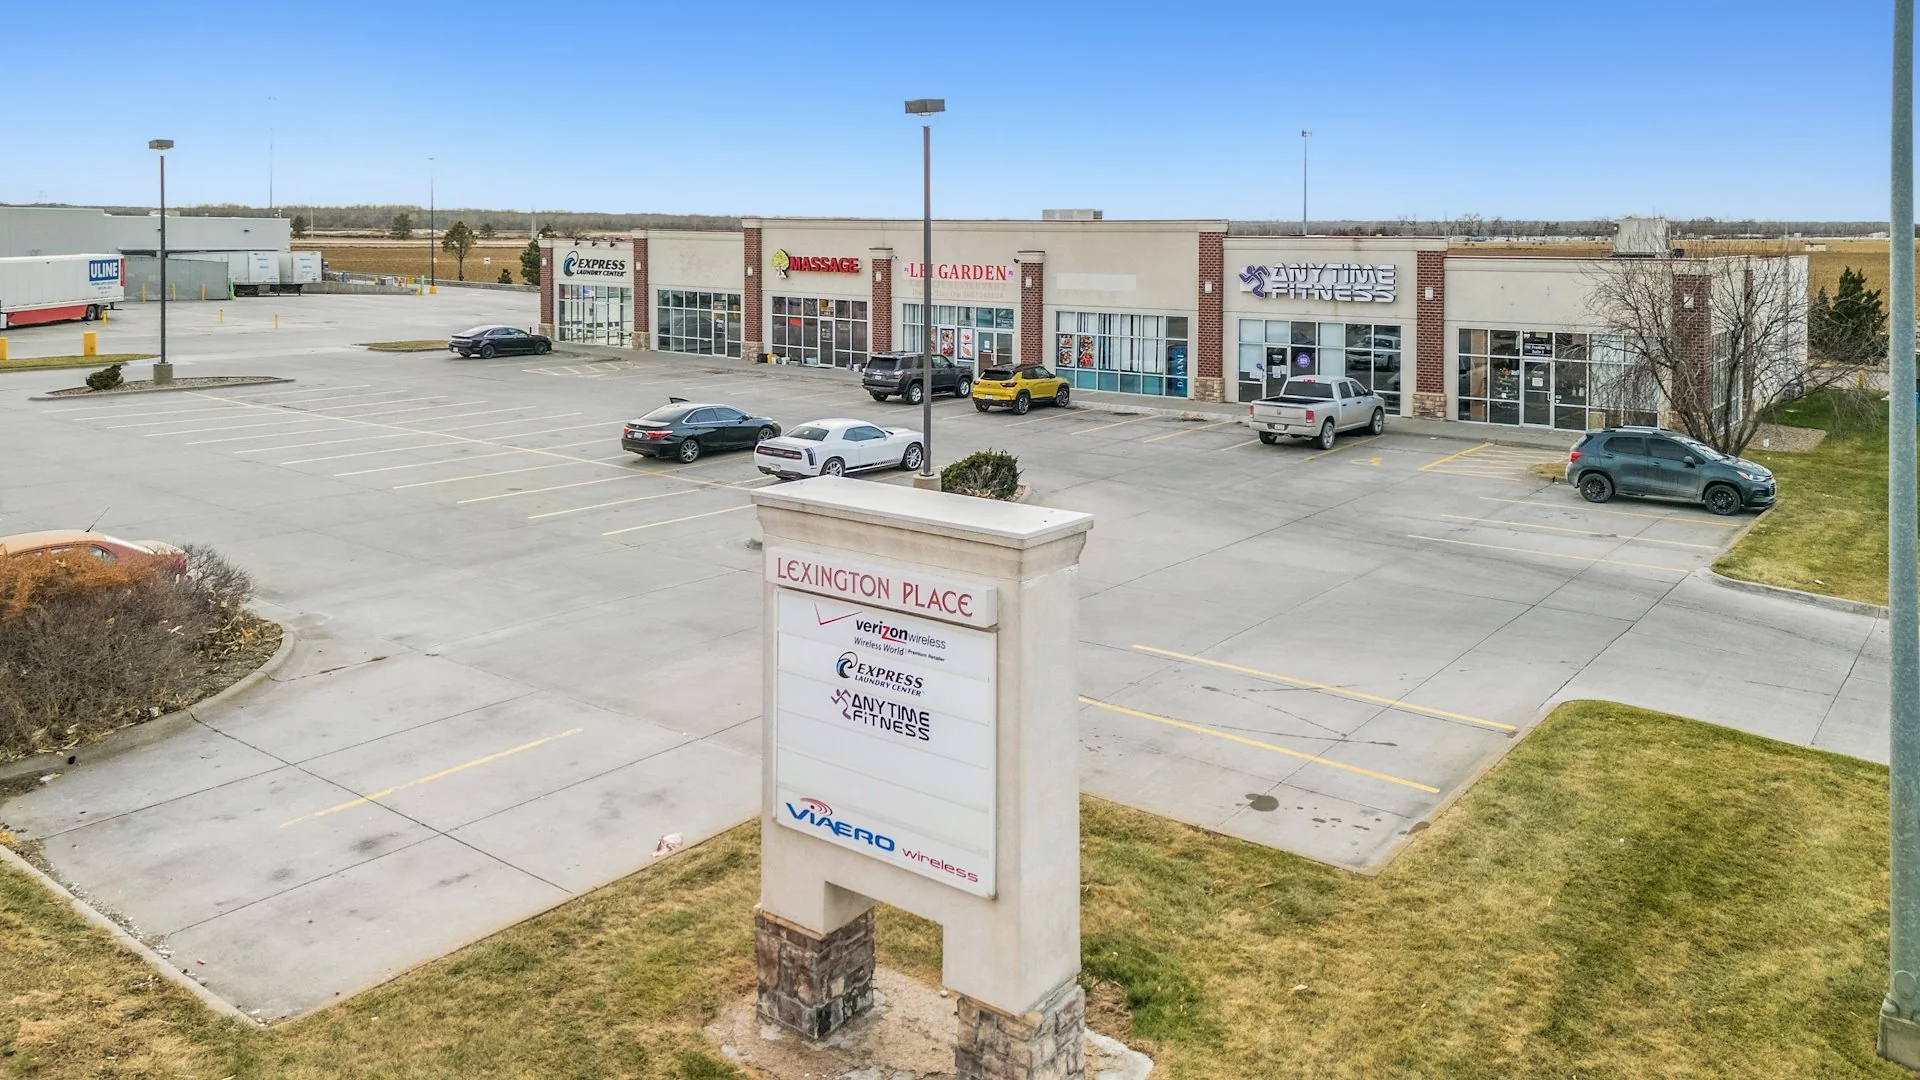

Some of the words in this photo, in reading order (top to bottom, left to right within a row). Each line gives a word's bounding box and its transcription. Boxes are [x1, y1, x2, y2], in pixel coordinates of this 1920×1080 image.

[90, 262, 118, 279] ULINE
[578, 258, 626, 270] EXPRESS
[789, 256, 859, 273] MASSAGE
[938, 264, 1007, 280] GARDEN
[1270, 263, 1396, 285] ANYTIME
[1177, 354, 1185, 388] DSANI
[778, 557, 890, 600] LEXINGTON
[903, 581, 973, 618] PLACE
[854, 636, 882, 650] Wireless
[883, 643, 905, 656] World
[855, 675, 891, 689] LAUNDRY
[892, 683, 922, 697] CENTER
[857, 663, 924, 689] EXPRESS
[852, 693, 929, 727] ANYTIME
[902, 847, 979, 883] wireless
